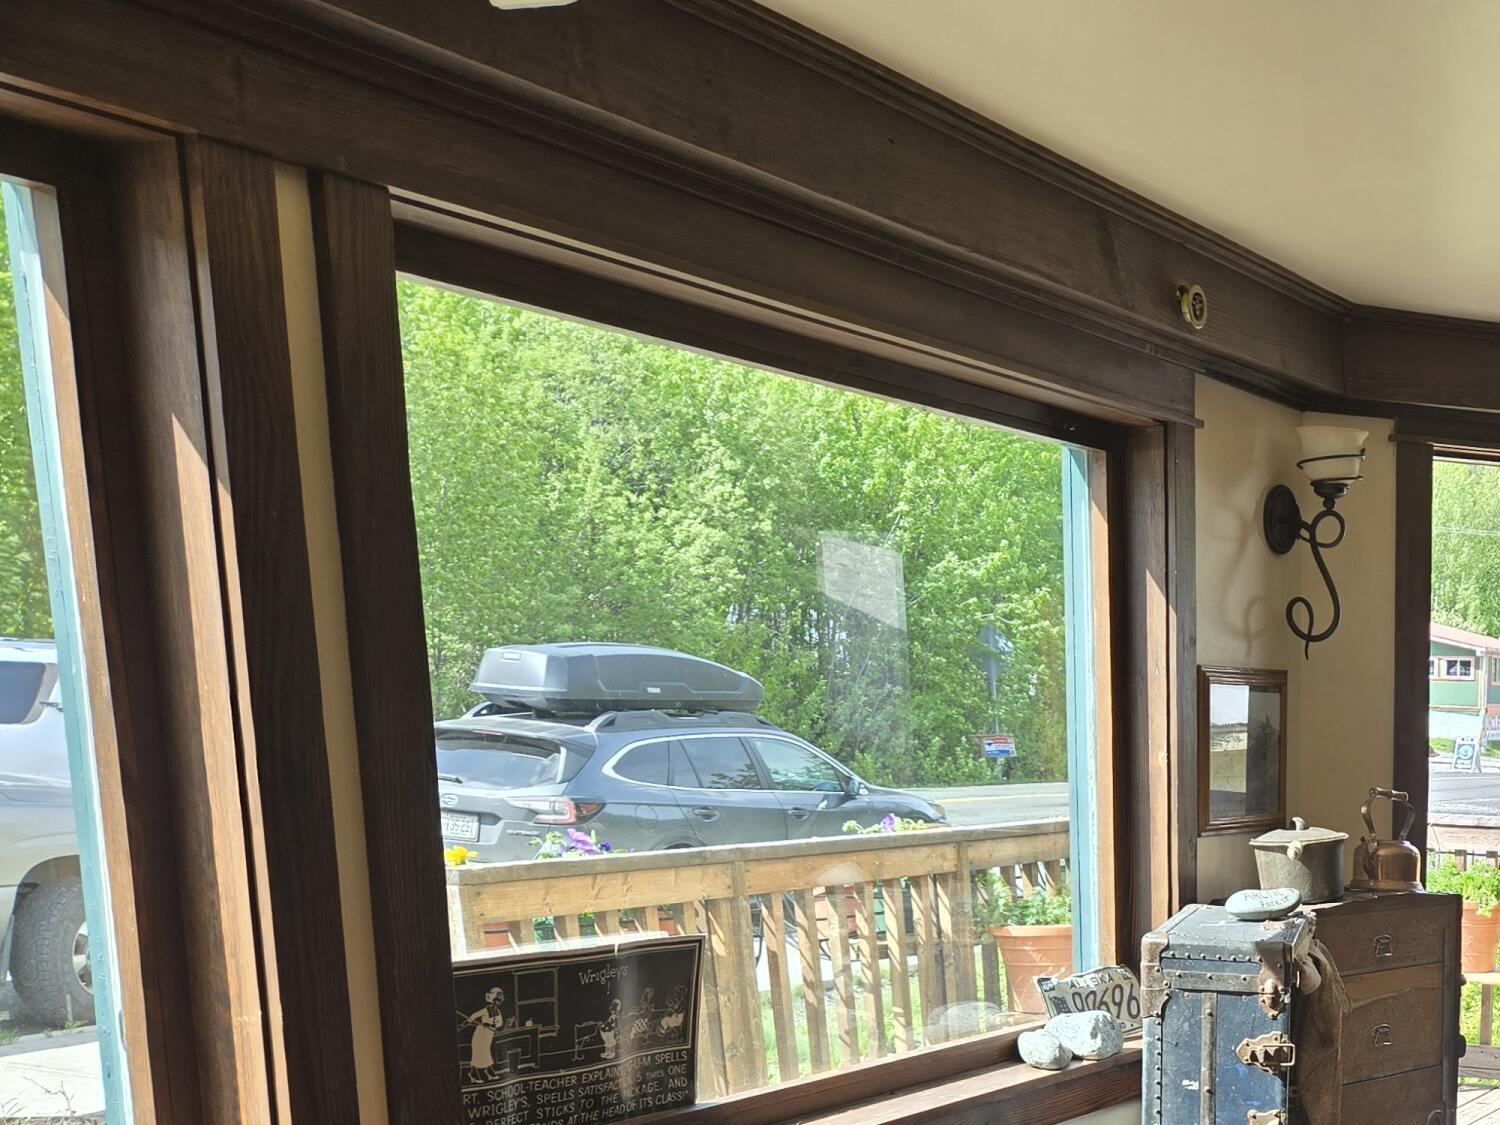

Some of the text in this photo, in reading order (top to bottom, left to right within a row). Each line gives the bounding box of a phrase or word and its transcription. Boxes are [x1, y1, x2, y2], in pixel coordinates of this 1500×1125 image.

[655, 1050, 688, 1065] SPELLS
[536, 1089, 575, 1105] SPELLS
[667, 1064, 688, 1076] ONE
[536, 1102, 576, 1119] STICKS
[580, 1099, 594, 1109] TO
[601, 1093, 619, 1106] THE
[668, 1077, 688, 1089] AND
[580, 1110, 599, 1122] THE
[601, 1104, 626, 1119] HEAD
[626, 1100, 637, 1112] OF
[640, 1096, 653, 1109] ITS
